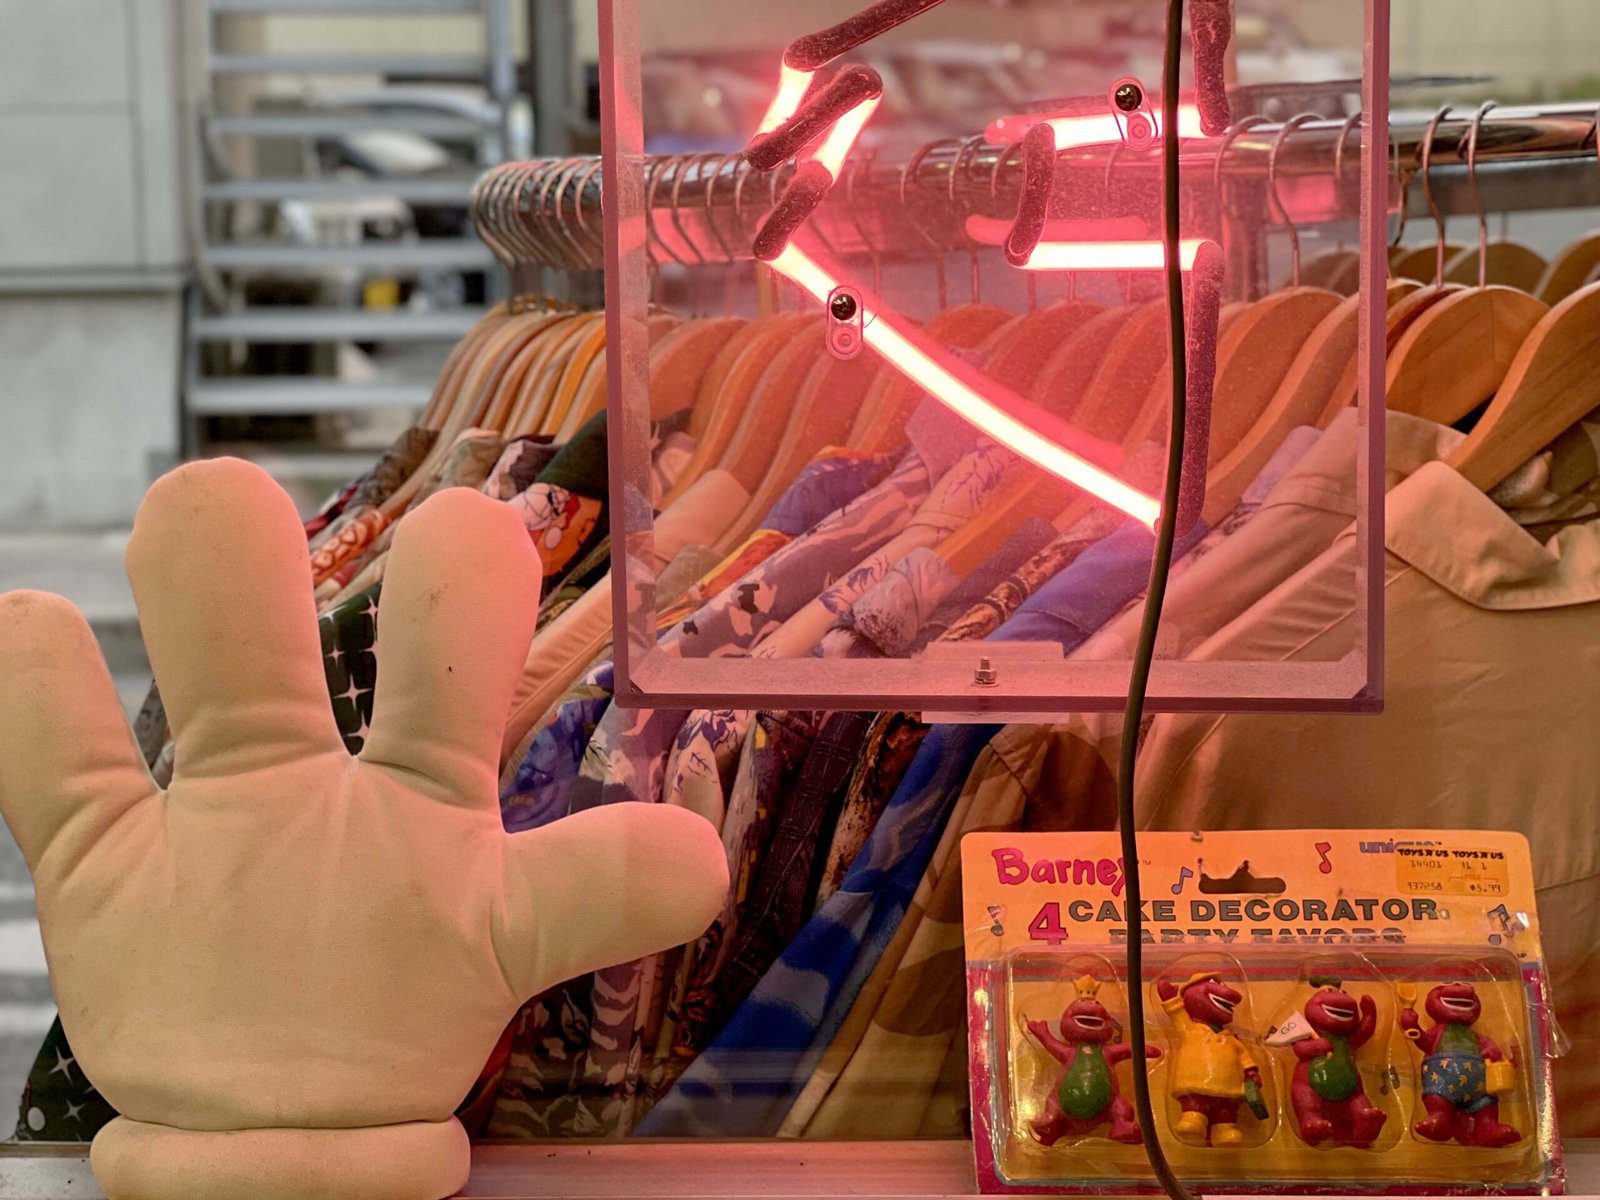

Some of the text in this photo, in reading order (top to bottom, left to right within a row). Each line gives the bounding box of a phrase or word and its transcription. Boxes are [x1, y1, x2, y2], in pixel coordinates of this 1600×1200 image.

[1397, 848, 1424, 857] TOYS
[1435, 849, 1449, 858] US
[1452, 850, 1479, 859] TOYS
[1490, 851, 1504, 860] US
[1028, 899, 1438, 945] 4 CAKE DECORATOR
